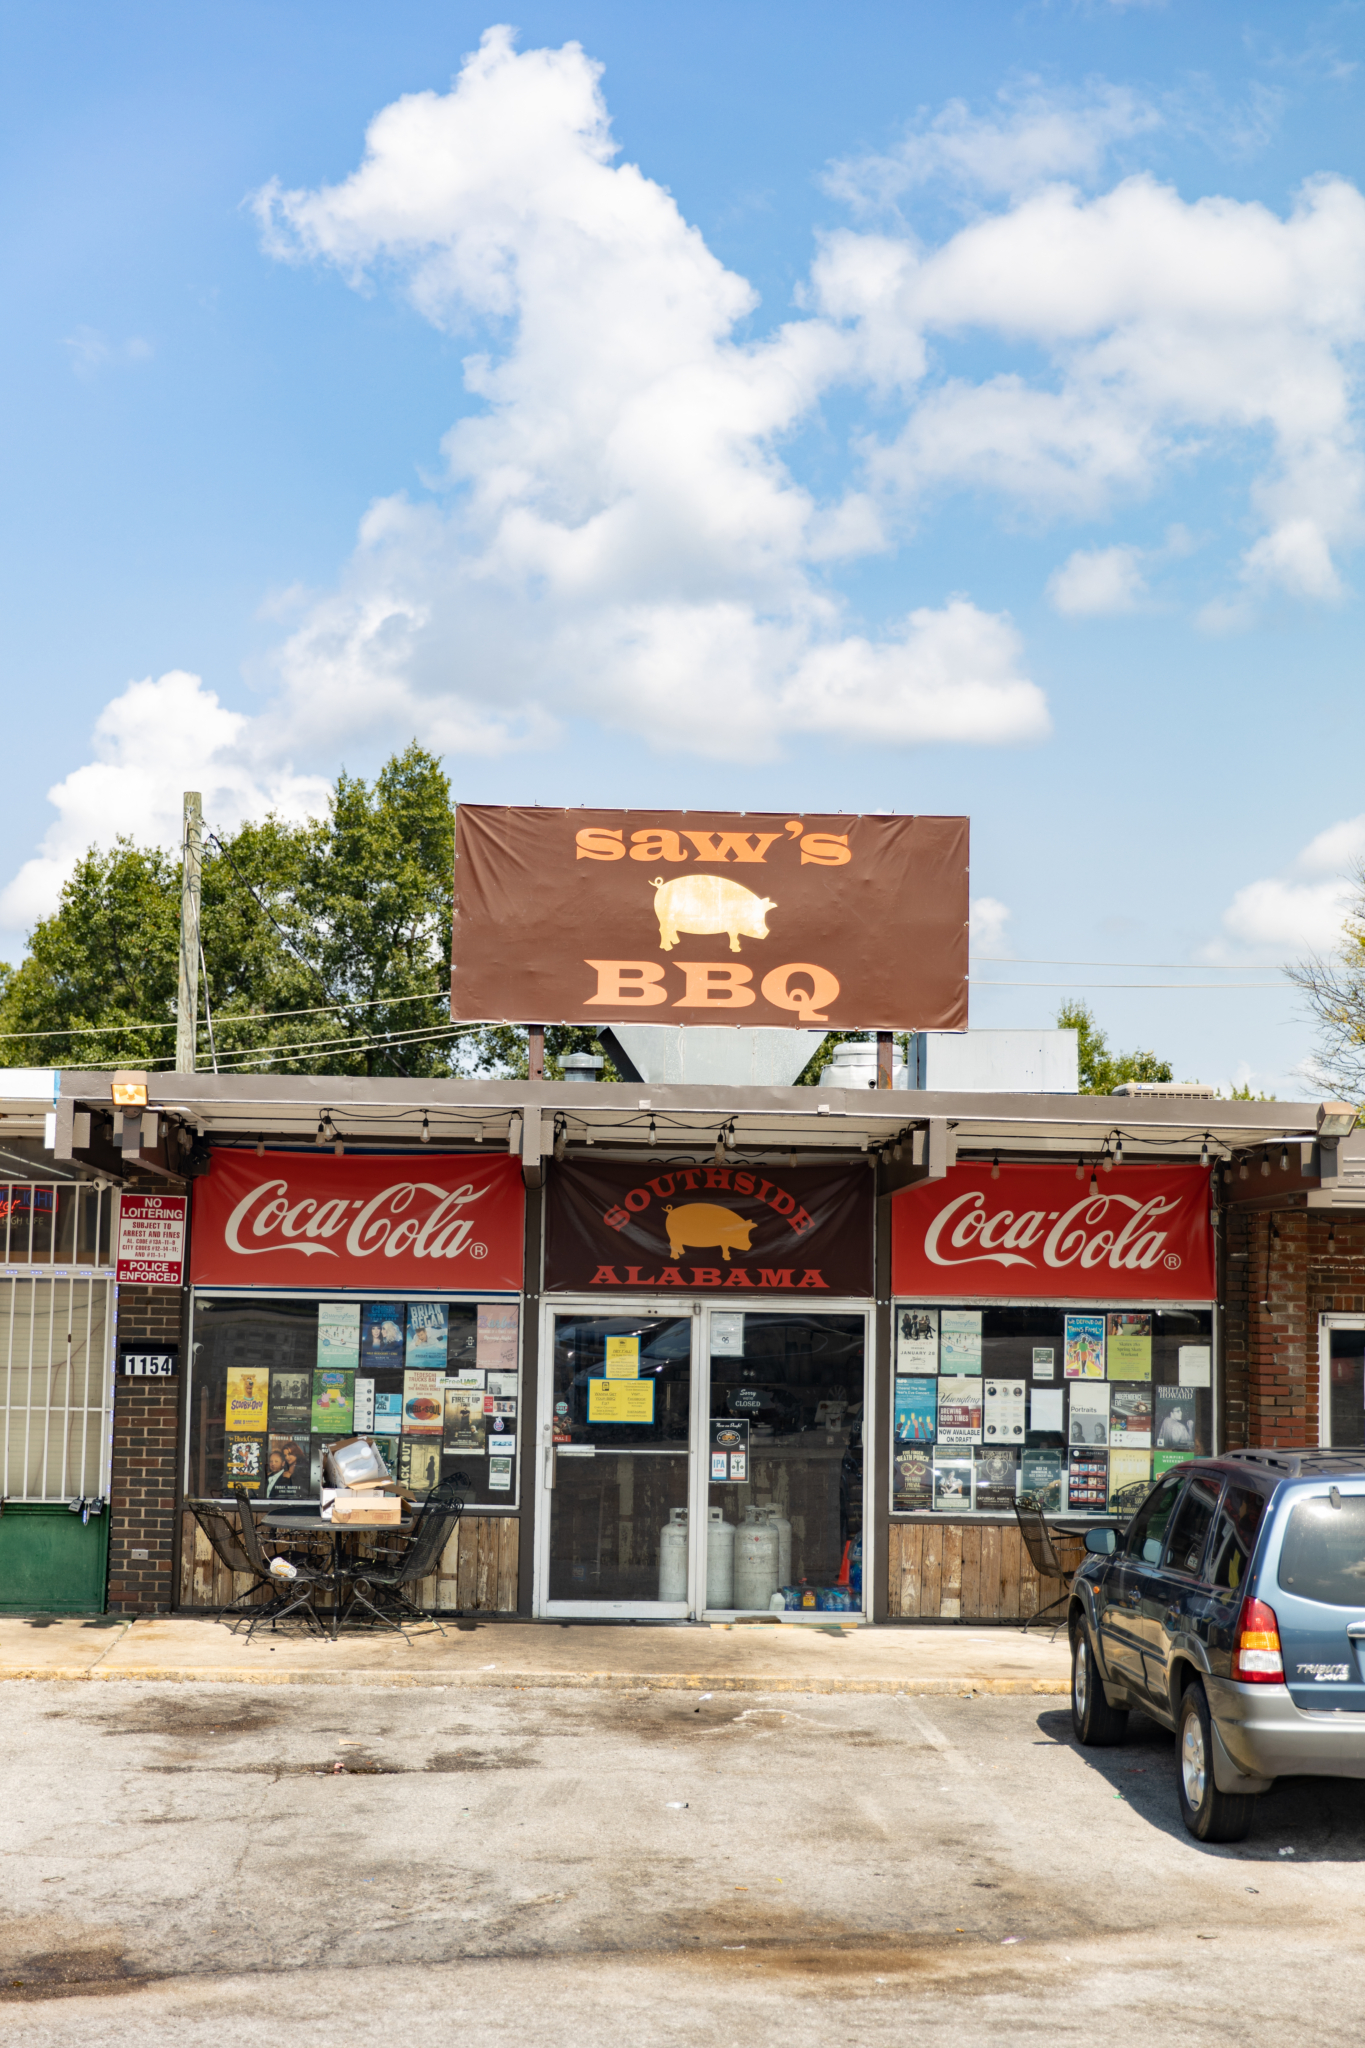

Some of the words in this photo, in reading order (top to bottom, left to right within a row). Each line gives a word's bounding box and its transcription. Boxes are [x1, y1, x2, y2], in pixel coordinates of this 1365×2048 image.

[575, 821, 852, 866] saw's
[582, 959, 841, 1022] BBQ
[144, 1198, 163, 1208] NO
[603, 1168, 816, 1236] SOUTHSIDE
[122, 1207, 183, 1220] LOITERING
[224, 1179, 491, 1258] Coca-Cola
[1, 1216, 23, 1225] HGH
[132, 1221, 161, 1230] SUBJECT
[163, 1222, 172, 1230] TO
[122, 1229, 147, 1238] ARREST
[924, 1191, 1183, 1269] Coca-Cola
[130, 1261, 170, 1272] POLICE
[119, 1270, 180, 1282] ENFORCED
[589, 1265, 831, 1288] ALABAMA
[410, 1304, 442, 1319] BRIAN
[411, 1312, 445, 1330] REGAN
[1085, 1326, 1104, 1335] FAMILY
[128, 1356, 171, 1375] 1154
[1158, 1386, 1195, 1394] BRITTANY
[938, 1391, 981, 1405] Yuengling
[1159, 1392, 1193, 1400] HOWARD
[424, 1403, 441, 1416] SOUL
[940, 1407, 962, 1415] BREWING
[1070, 1406, 1098, 1414] Portraits
[940, 1414, 954, 1422] GOOD
[954, 1414, 969, 1422] TIMES
[402, 1442, 411, 1462] OUT
[713, 1459, 726, 1469] IPA
[912, 1454, 930, 1463] PUNCH
[1296, 1663, 1350, 1674] TRIBUTE
